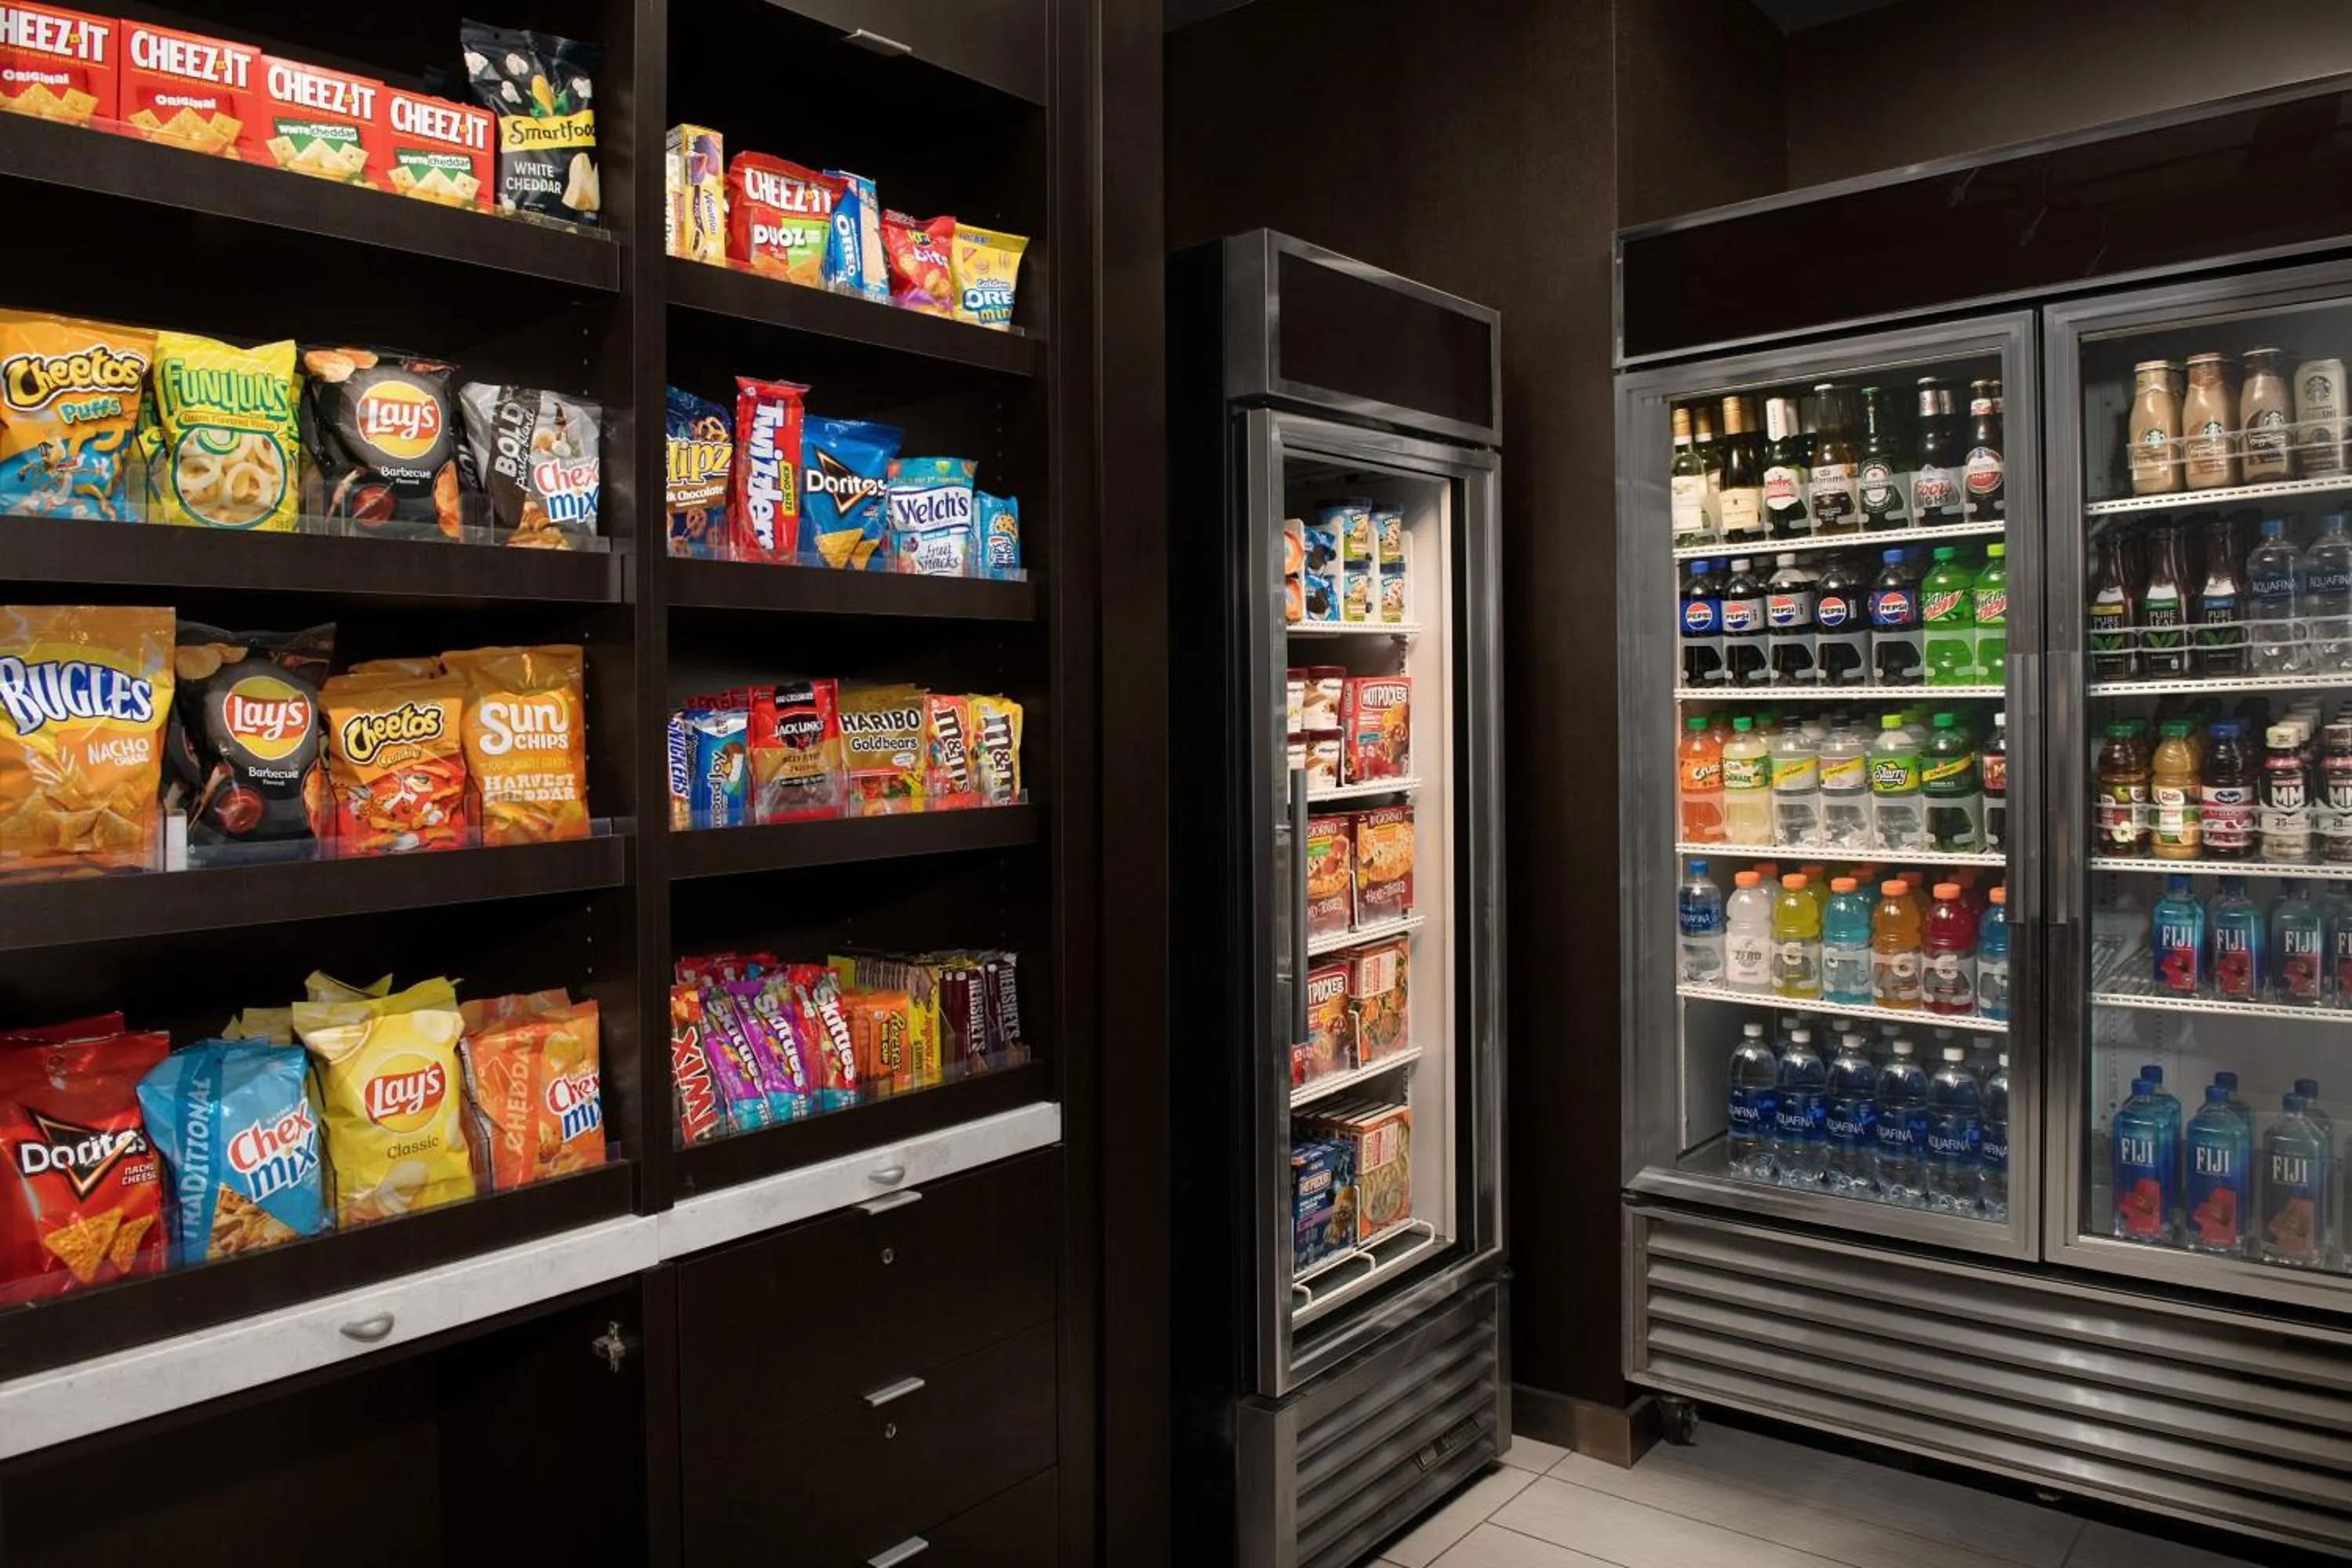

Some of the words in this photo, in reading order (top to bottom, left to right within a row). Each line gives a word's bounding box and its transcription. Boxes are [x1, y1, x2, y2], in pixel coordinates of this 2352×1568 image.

[0, 9, 109, 63] HEEZ-IT
[510, 119, 595, 145] Smartfoo
[514, 161, 554, 177] WHITE
[506, 176, 562, 194] CHEDDAR
[753, 224, 806, 247] DUOZ
[964, 290, 1014, 311] ORE
[3, 344, 147, 410] Cheetos
[59, 397, 122, 425] Puffs
[366, 397, 437, 441] Lay's
[495, 401, 525, 477] BOLD
[380, 465, 432, 479] Barbecue
[666, 437, 734, 485] lipz
[747, 398, 785, 551] Twizzlers
[535, 458, 600, 493] Chex
[806, 469, 887, 497] Doritos
[677, 484, 725, 501] Chocolate
[895, 491, 969, 524] Welch's
[917, 553, 960, 571] Snacks
[1881, 604, 1907, 612] PEPSI
[2093, 615, 2120, 626] PURE
[2149, 610, 2177, 620] PURE
[2208, 610, 2233, 619] PURE
[0, 655, 154, 735] BUGLES
[234, 693, 307, 741] Lay's
[774, 722, 798, 738] JACK
[839, 708, 921, 733] HARIBO
[343, 702, 445, 763] Cheetos
[512, 733, 569, 750] CHIPS
[851, 737, 919, 752] Goldbears
[88, 737, 150, 767] NACHO
[668, 717, 689, 799] SNICKERS
[248, 765, 299, 779] Barbecue
[484, 773, 575, 793] HARVEST
[2161, 924, 2193, 949] FIJI
[2216, 927, 2247, 951] FIJI
[2285, 930, 2318, 953] FIJI
[2338, 932, 2352, 954] FI
[1734, 950, 1762, 961] ZERO
[997, 964, 1021, 1041] HERSHEY'S
[753, 993, 806, 1089] Skittles
[812, 982, 856, 1086] Skittles
[372, 1065, 443, 1119] Lay's
[670, 1025, 719, 1146] TWIX
[229, 1099, 314, 1171] Chex
[387, 1134, 440, 1160] Classic
[20, 1129, 147, 1176] Doritos
[180, 1076, 212, 1238] TRADITIONAL
[2121, 1137, 2154, 1164] FIJI
[2196, 1145, 2230, 1174] FIJI
[2273, 1155, 2308, 1182] FIJI
